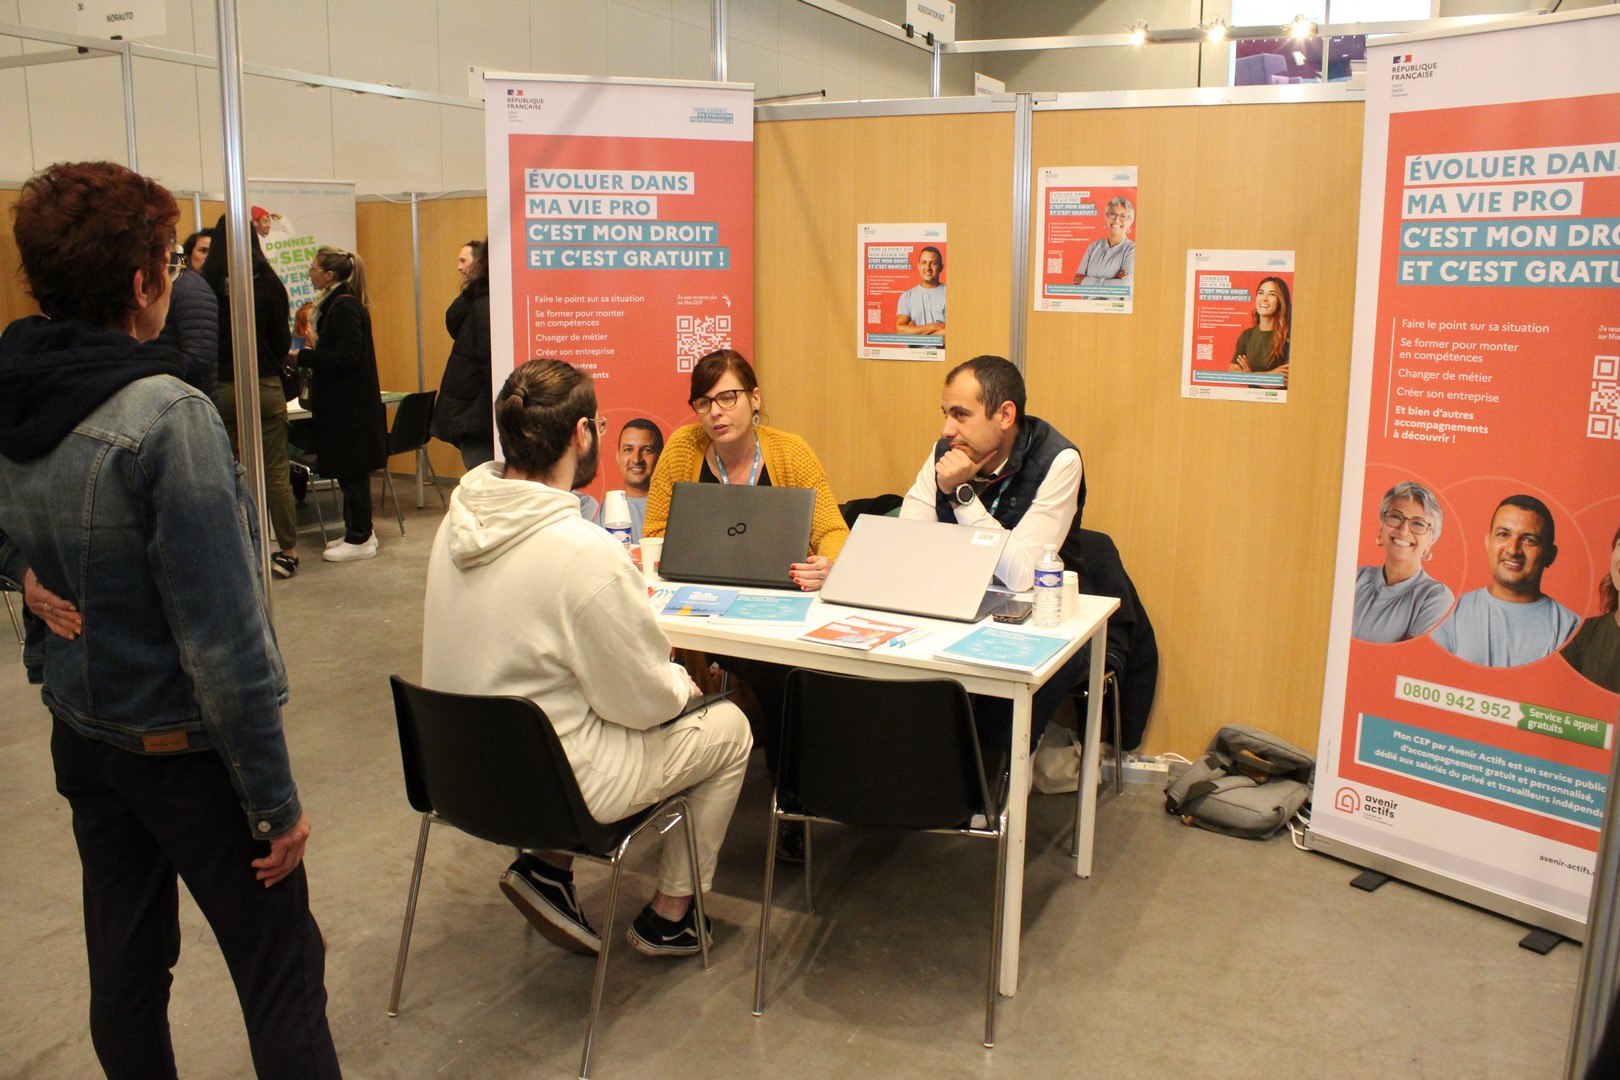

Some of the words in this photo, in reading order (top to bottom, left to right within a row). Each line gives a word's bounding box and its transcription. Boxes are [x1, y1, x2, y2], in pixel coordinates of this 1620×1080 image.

[106, 12, 134, 22] NORAUTO
[1392, 62, 1437, 73] RÉPUBLIQUE
[1392, 71, 1433, 80] FRANÇAISE
[1410, 156, 1536, 181] ÉVOLUER
[1547, 150, 1620, 175] DAN
[529, 170, 624, 189] ÉVOLUER
[631, 174, 688, 191] DANS
[530, 199, 562, 214] MA
[568, 200, 601, 215] VIE
[609, 201, 651, 215] PRO
[1408, 194, 1447, 214] MA
[1456, 192, 1502, 213] VIE
[1513, 189, 1573, 212] PRO
[529, 224, 586, 241] C’EST
[593, 225, 642, 241] MON
[650, 226, 713, 241] DROIT
[1404, 227, 1477, 248] C’EST
[1486, 225, 1557, 248] MON
[265, 236, 315, 251] DONNEZ
[530, 250, 555, 266] ET
[560, 250, 617, 266] C’EST
[623, 251, 713, 267] GRATUIT
[719, 252, 724, 267] !
[287, 264, 309, 272] VOTRE
[1402, 261, 1433, 281] ET
[1440, 261, 1517, 282] C’EST
[564, 296, 585, 305] point
[547, 319, 599, 328] compétences
[1402, 319, 1424, 328] Faire
[1428, 320, 1437, 329] le
[1439, 320, 1467, 332] point
[1502, 323, 1549, 333] situation
[536, 334, 568, 343] Changer
[1401, 338, 1412, 347] Se
[1414, 338, 1449, 348] former
[1452, 342, 1477, 351] pour
[1480, 342, 1519, 352] monter
[575, 348, 614, 357] entreprise
[1414, 351, 1483, 363] compétences
[1398, 369, 1439, 381] Changer
[1443, 371, 1456, 380] de
[1458, 372, 1492, 382] métier
[1397, 387, 1423, 397] Créer
[1447, 391, 1499, 403] entreprise
[1396, 406, 1405, 414] Et
[1408, 407, 1429, 416] bien
[1432, 408, 1474, 420] d’autres
[1394, 419, 1488, 434] accompagnements
[1393, 430, 1399, 438] à
[1402, 431, 1450, 442] découvrir
[1403, 683, 1440, 702] 0800
[1446, 693, 1475, 711] 942
[1480, 700, 1511, 720] 952
[1528, 719, 1563, 734] gratuits
[1530, 708, 1562, 724] Service
[1565, 716, 1571, 725] &
[1573, 719, 1598, 732] appel
[1394, 730, 1411, 742] Mon
[1414, 735, 1431, 746] CEP
[1433, 741, 1447, 752] par
[1449, 745, 1477, 758] Avenir
[1479, 753, 1506, 766] Actifs
[1508, 762, 1522, 770] est
[1525, 765, 1536, 774] un
[1538, 769, 1572, 784] service
[1575, 778, 1606, 793] public
[1375, 748, 1397, 761] dédié
[1399, 757, 1414, 766] aux
[1415, 759, 1447, 775] salariés
[1449, 769, 1460, 778] du
[1462, 773, 1485, 786] privé
[1487, 780, 1496, 788] et
[1498, 782, 1550, 803] travailleurs
[1485, 766, 1516, 782] gratuit
[1518, 775, 1528, 784] et
[1530, 779, 1594, 803] personnalisé,
[1365, 795, 1398, 809] avenir
[1365, 804, 1394, 818] actifs
